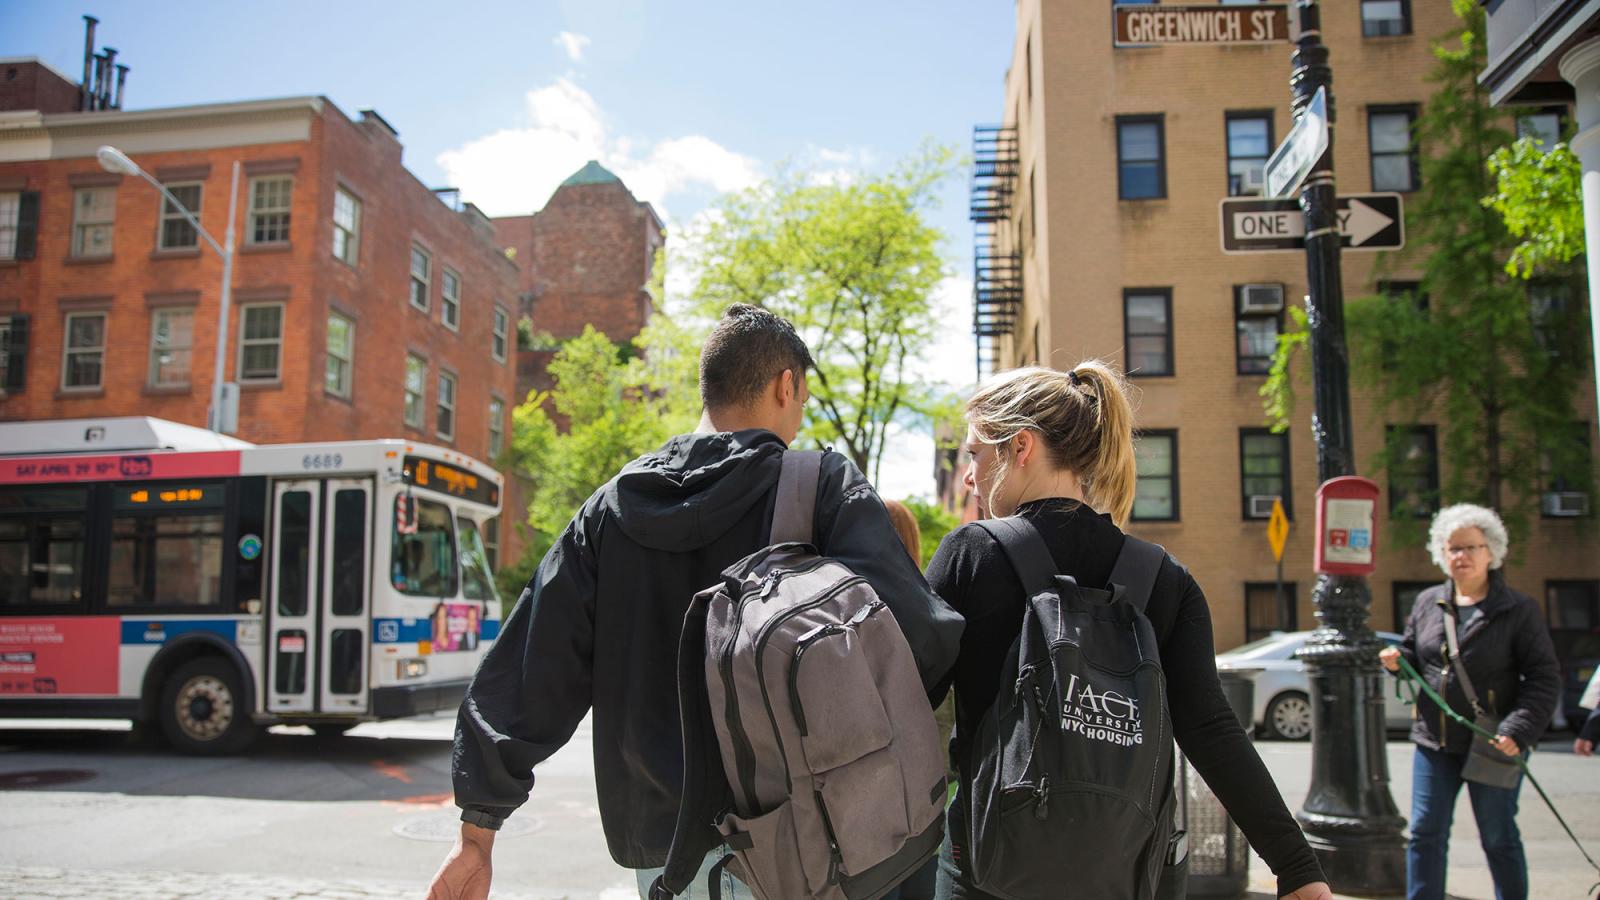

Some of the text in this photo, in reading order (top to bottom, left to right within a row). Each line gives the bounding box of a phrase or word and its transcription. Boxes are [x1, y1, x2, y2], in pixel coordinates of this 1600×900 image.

[1127, 10, 1276, 42] GREENWICH ST
[1241, 214, 1289, 235] ONE
[1061, 718, 1143, 747] NYC HOUSING
